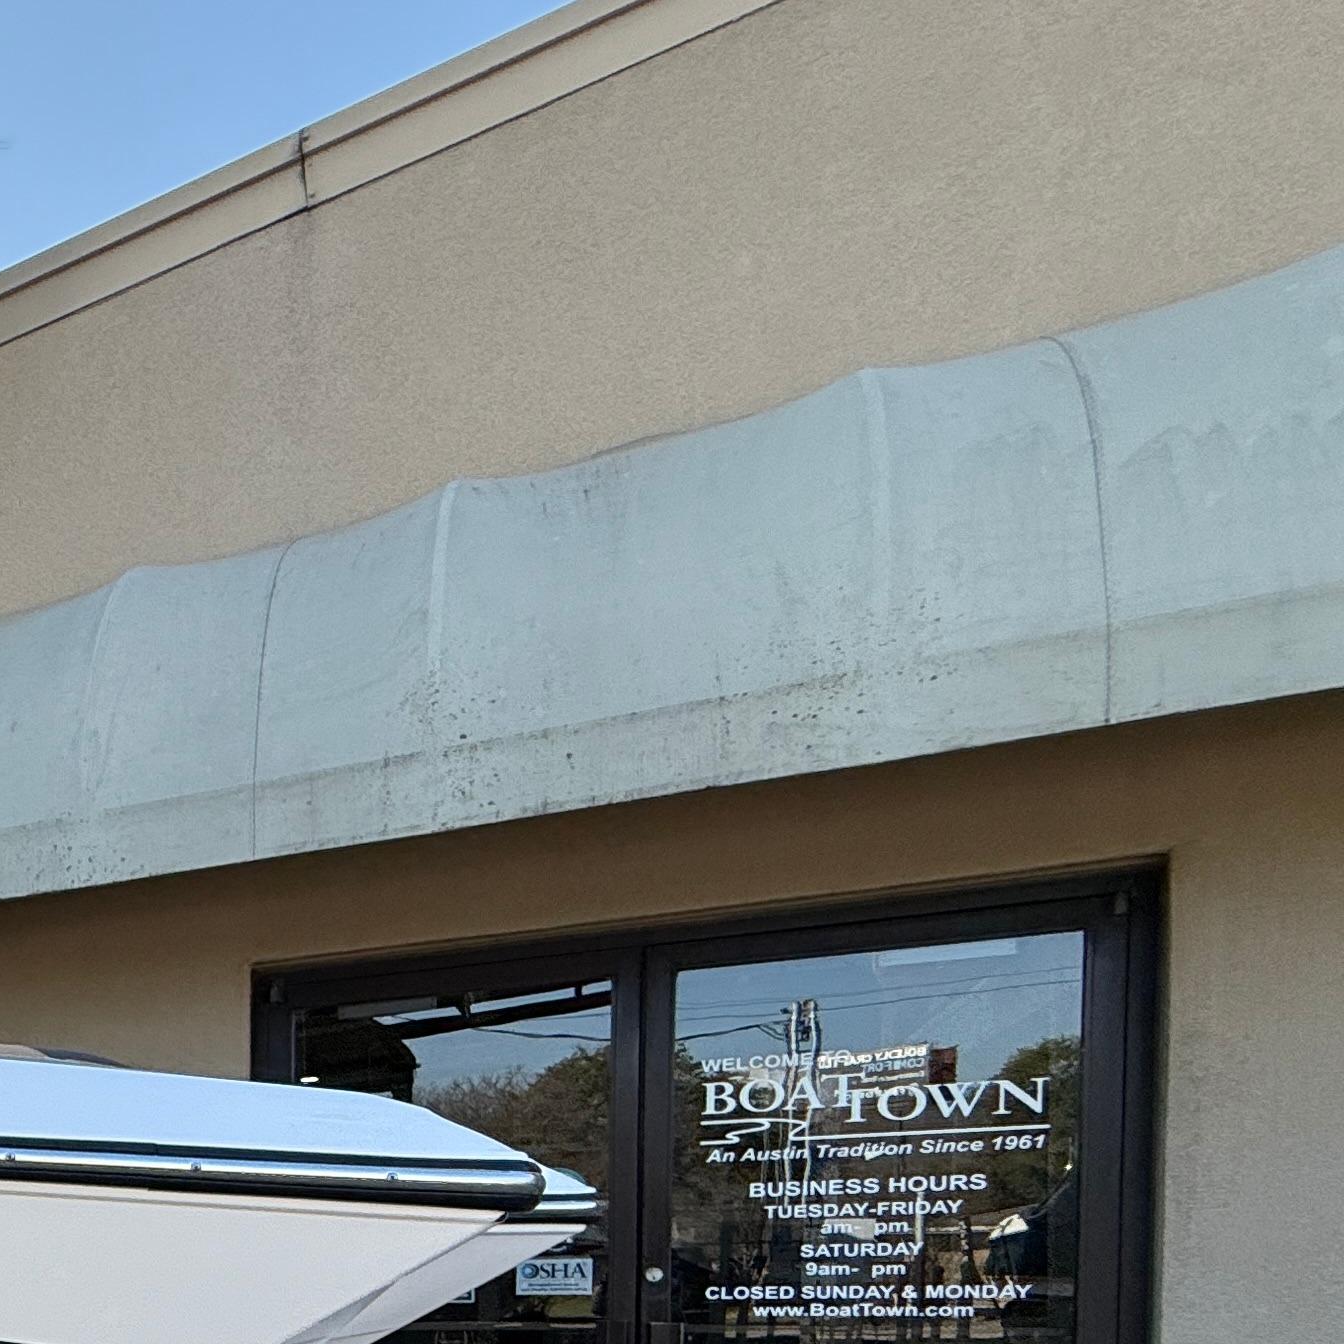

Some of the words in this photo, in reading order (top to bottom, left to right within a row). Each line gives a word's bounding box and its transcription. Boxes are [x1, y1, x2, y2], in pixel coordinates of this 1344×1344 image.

[701, 1053, 814, 1073] WELCOME
[706, 1148, 736, 1163] An
[739, 1146, 808, 1162] Austin
[817, 1141, 912, 1158] Tradition
[919, 1138, 984, 1154] Since
[992, 1134, 1046, 1150] 1961
[748, 1177, 880, 1198] BUSINESS
[889, 1173, 988, 1193] HOURS
[764, 1200, 963, 1219] TUESDAY-FRIDAY
[874, 1221, 909, 1237] pm
[800, 1241, 924, 1258] SATURDAY
[521, 1263, 587, 1279] OSHA
[871, 1264, 906, 1279] pm
[705, 1286, 795, 1301] CLOSED
[800, 1285, 895, 1300] SUNDAY
[902, 1284, 918, 1299] &
[925, 1284, 1033, 1300] MONDAY
[753, 1303, 974, 1319] www.BoatTown.com
